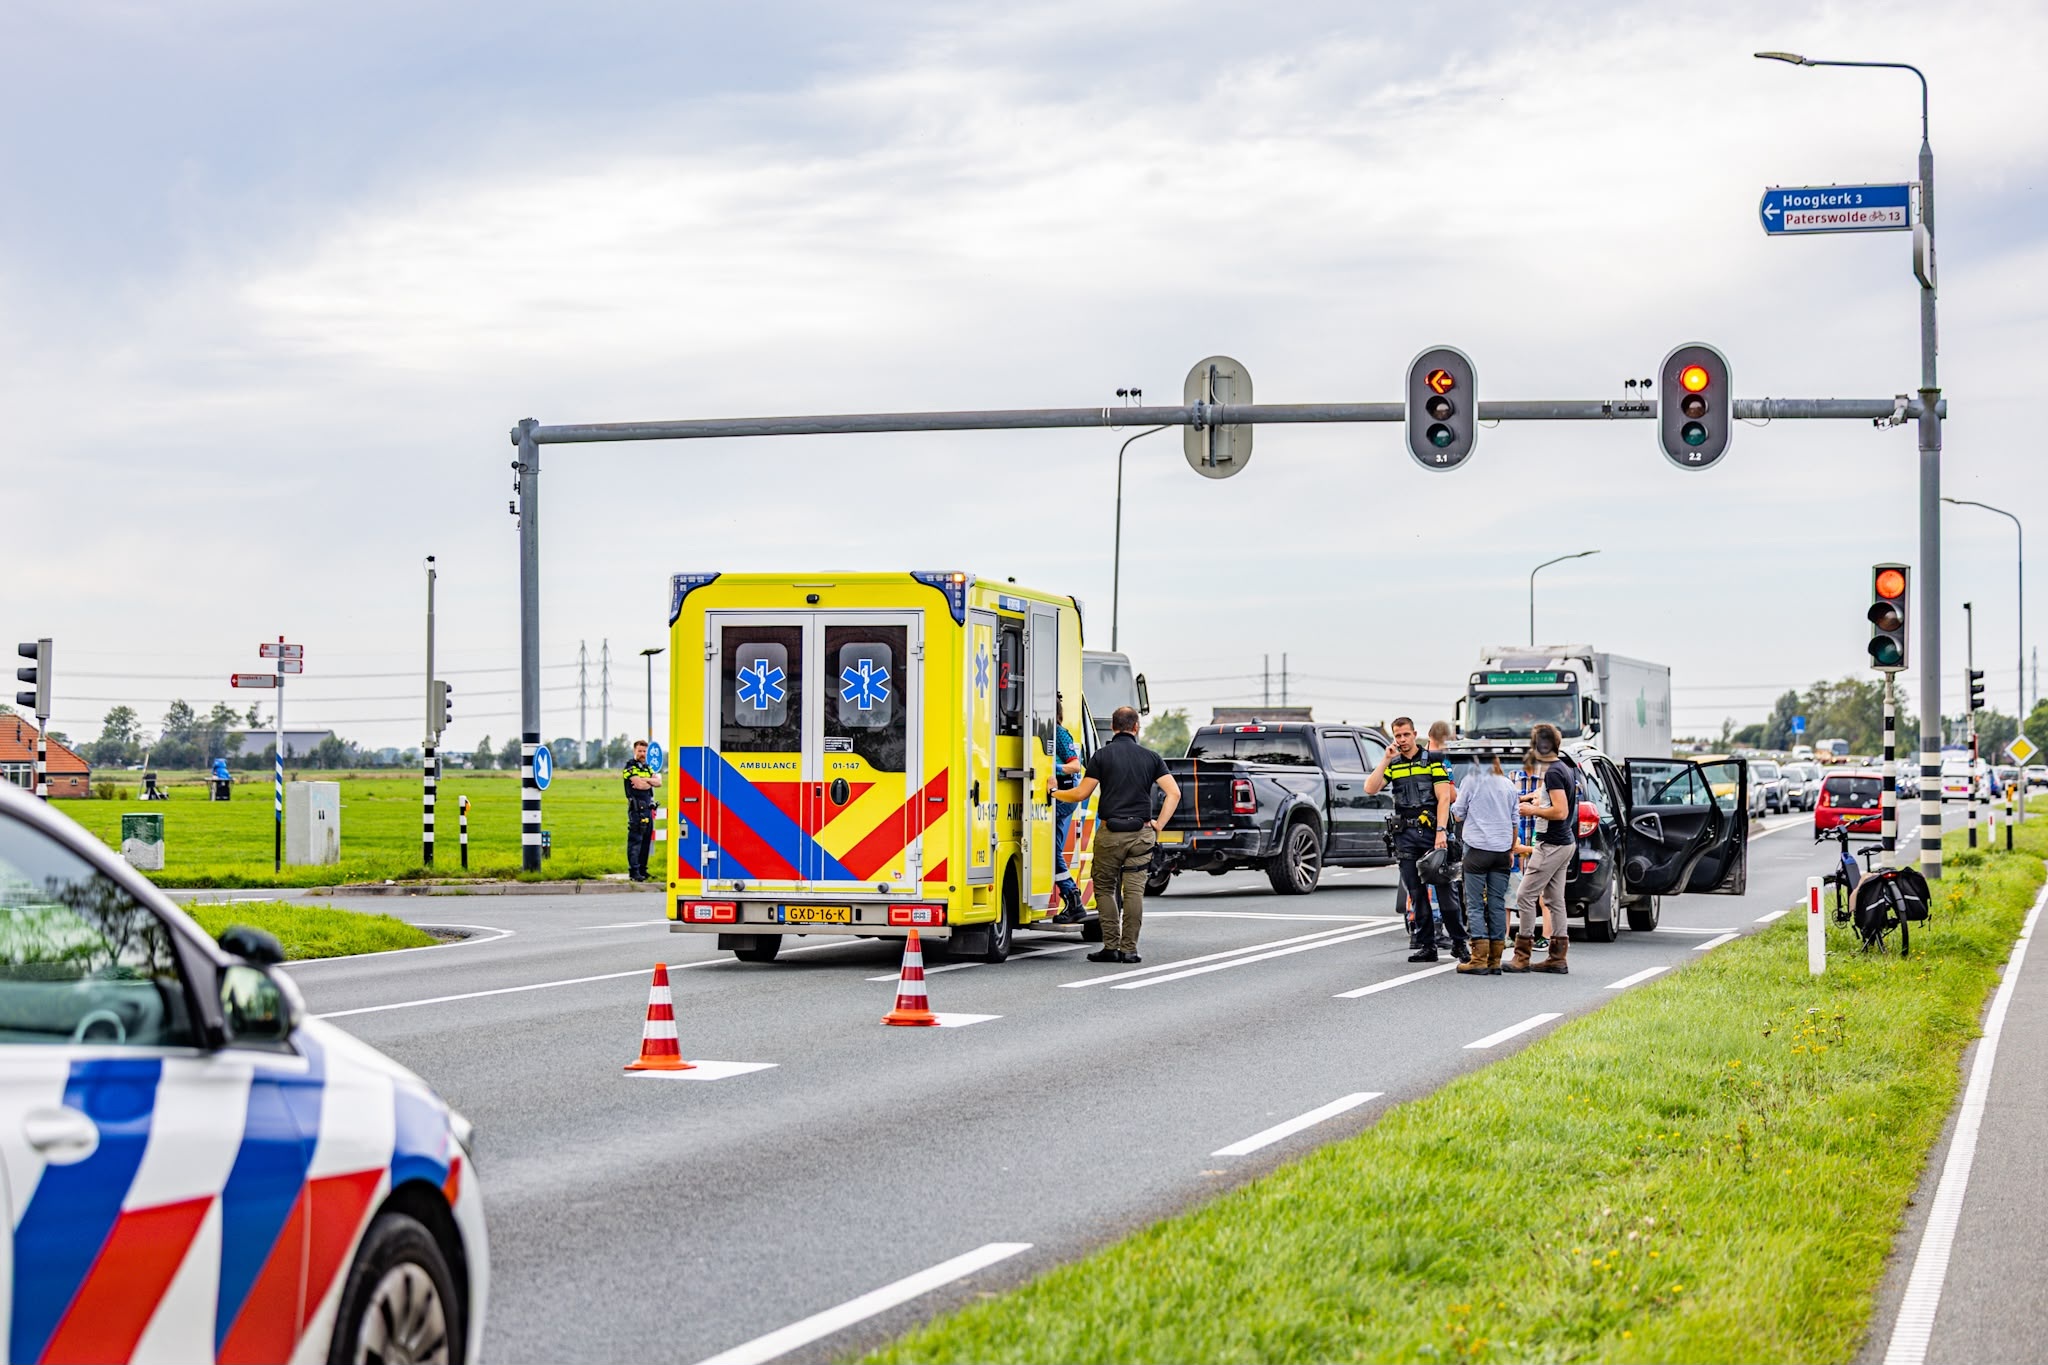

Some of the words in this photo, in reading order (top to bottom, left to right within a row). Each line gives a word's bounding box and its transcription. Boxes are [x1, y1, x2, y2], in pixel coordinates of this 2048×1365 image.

[1783, 193, 1852, 208] Hoogkerk
[1855, 194, 1862, 204] 3
[1786, 212, 1867, 224] Paterswolde
[1889, 212, 1901, 221] 13
[1435, 454, 1448, 463] 3.1
[790, 908, 845, 920] GXD-16-K
